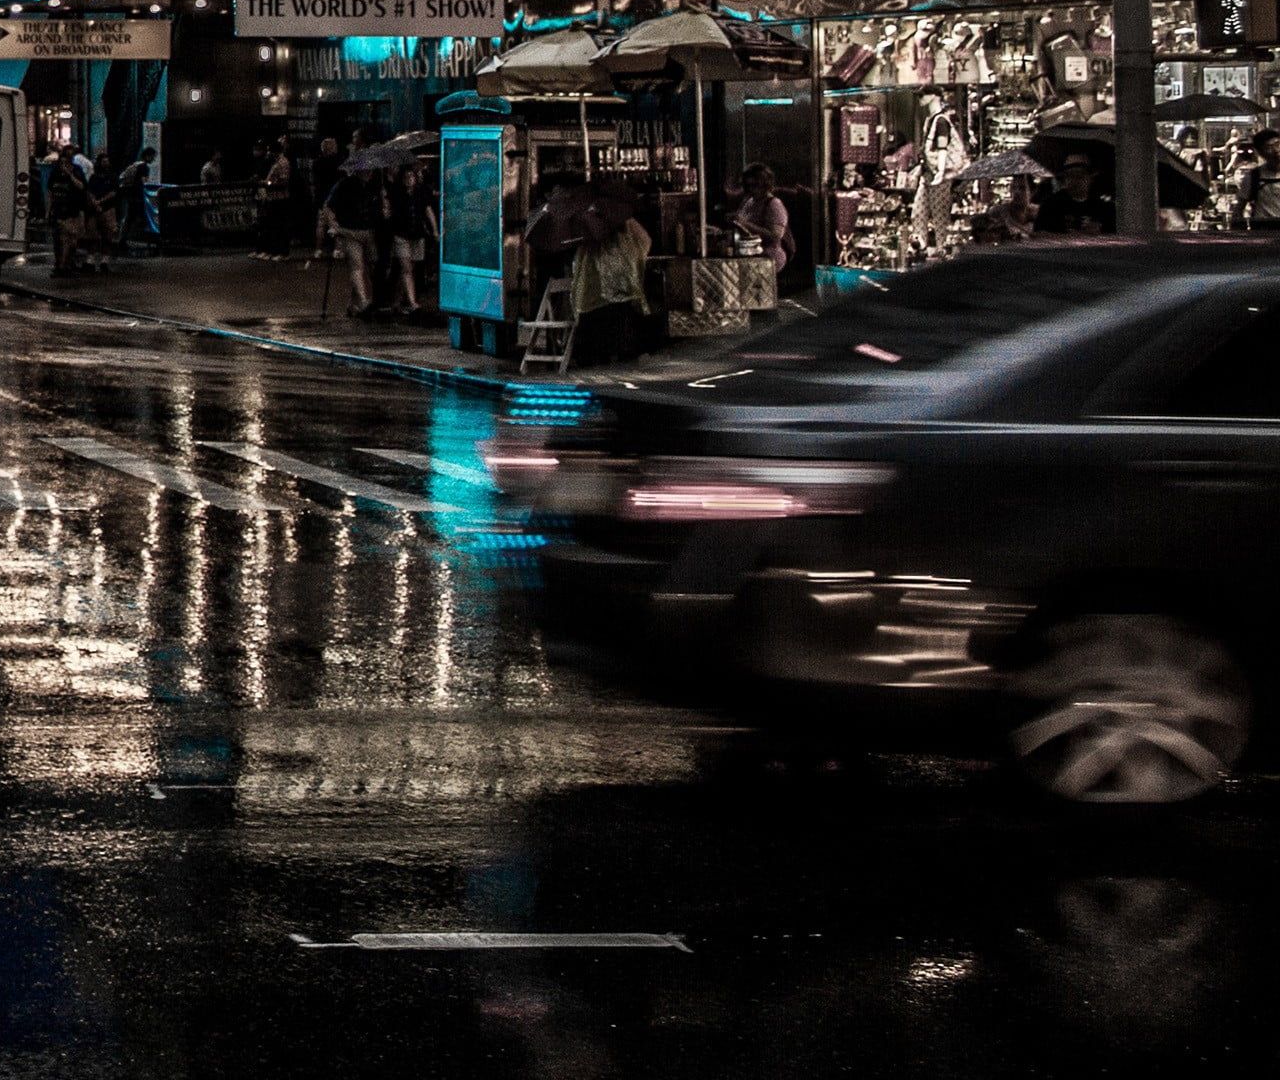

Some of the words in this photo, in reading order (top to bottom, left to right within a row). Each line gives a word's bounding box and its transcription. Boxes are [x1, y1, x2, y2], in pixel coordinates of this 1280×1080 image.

[16, 33, 61, 44] AROUND
[64, 34, 84, 44] THE
[90, 33, 131, 44] CORNER
[33, 45, 50, 55] ON
[53, 45, 113, 55] BROADWAY
